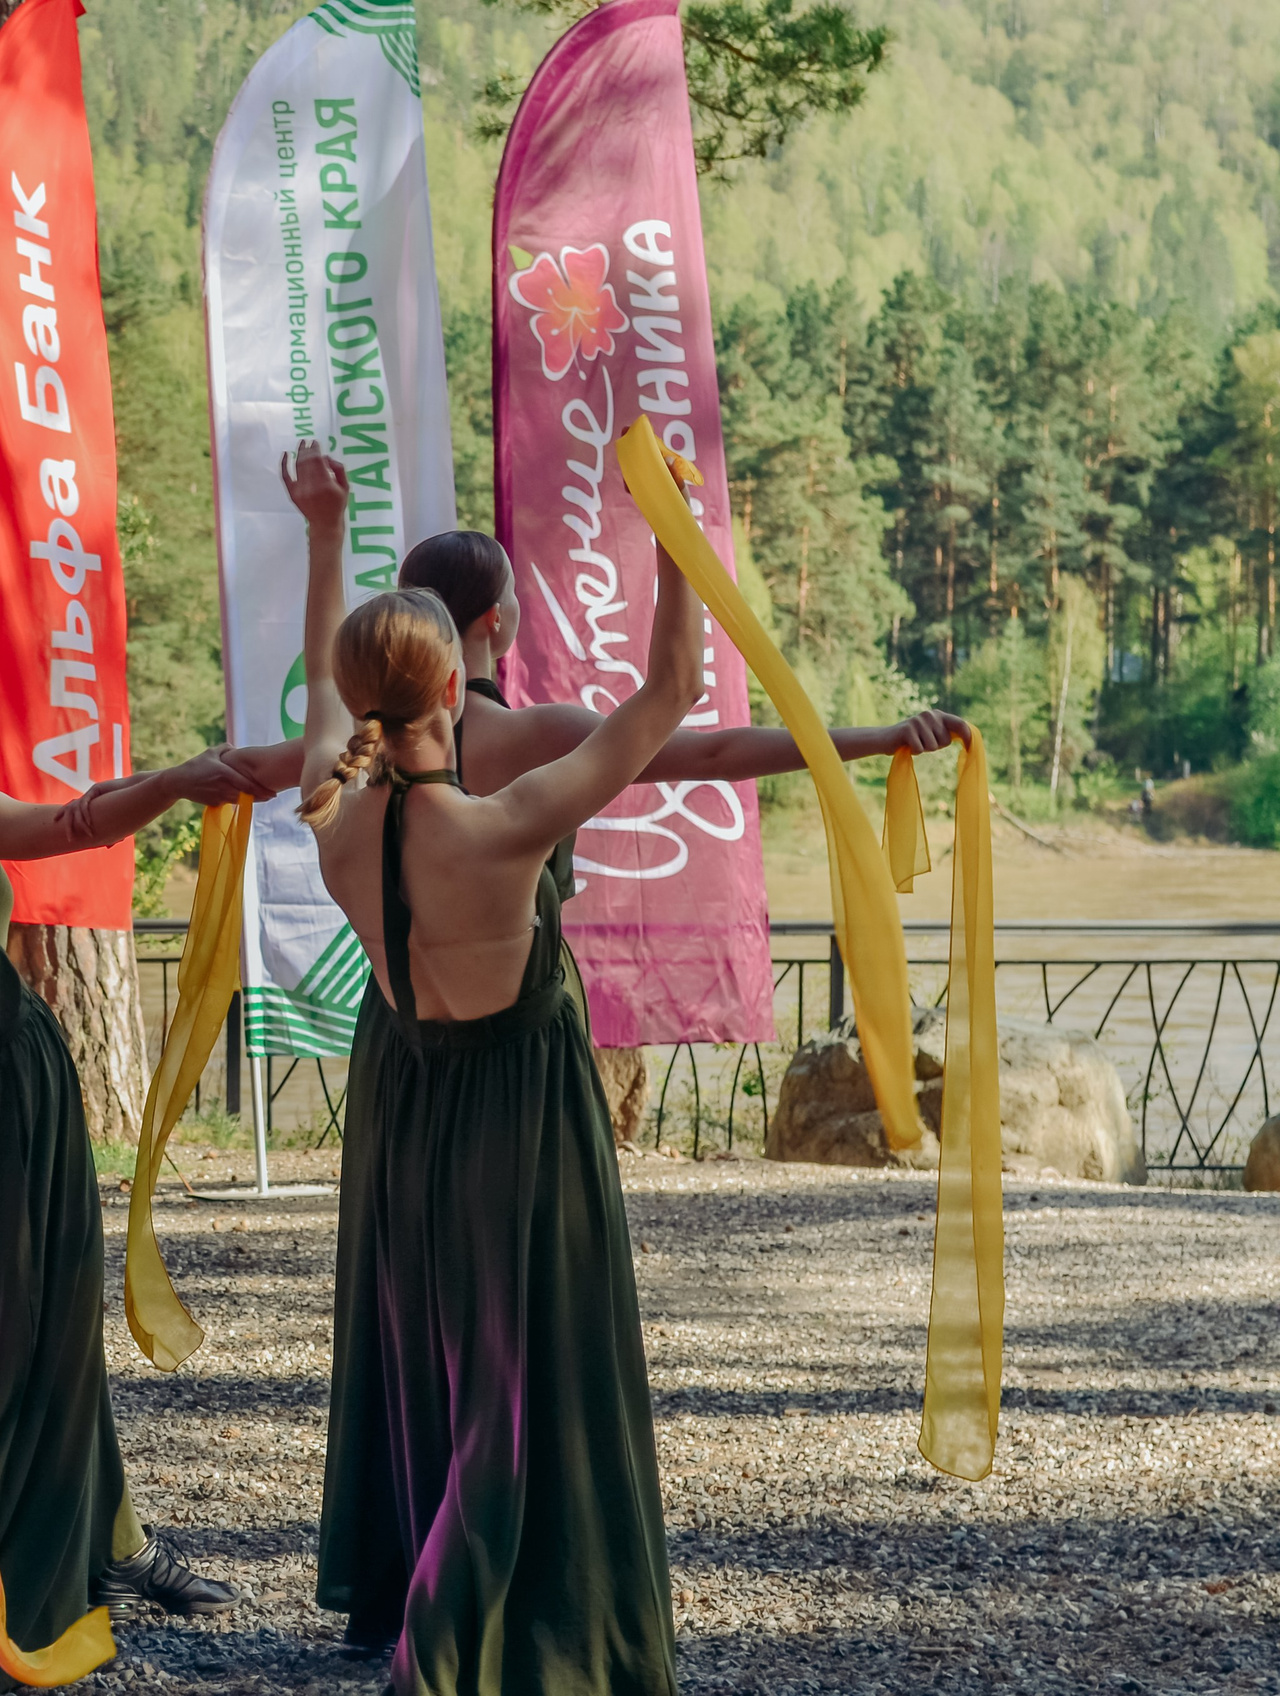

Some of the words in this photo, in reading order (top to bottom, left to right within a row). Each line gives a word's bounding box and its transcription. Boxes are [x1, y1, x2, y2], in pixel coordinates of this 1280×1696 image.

[272, 100, 298, 178] центр
[314, 98, 363, 229] КРАЯ
[11, 170, 72, 433] Банк
[273, 188, 315, 438] информационный
[325, 251, 397, 591] АЛТАЙСКОГО
[31, 457, 103, 796] Альфа
